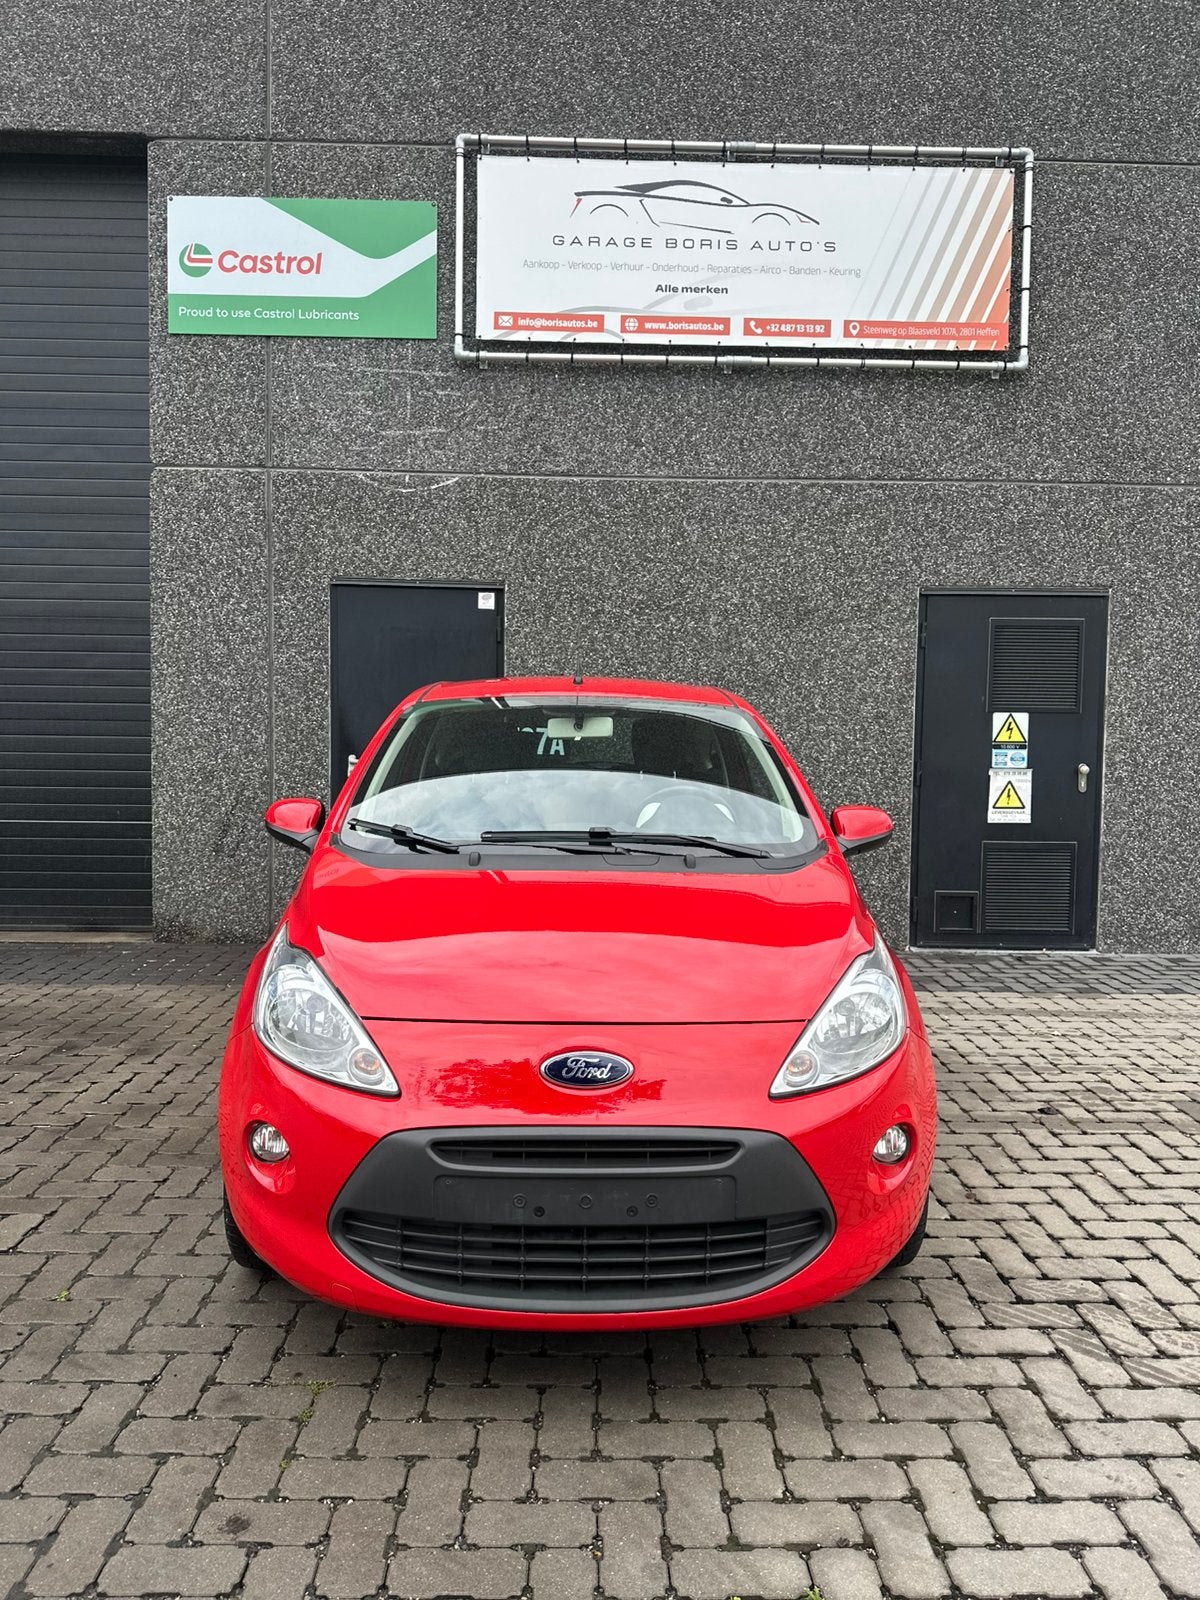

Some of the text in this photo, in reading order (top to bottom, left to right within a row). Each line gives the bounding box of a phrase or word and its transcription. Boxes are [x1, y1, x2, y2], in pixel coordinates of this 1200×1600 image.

[552, 235, 837, 252] GARAGE BORIS AUTO'S
[218, 249, 323, 275] Castrol
[522, 259, 560, 270] Aankoop
[567, 261, 603, 271] Verkoop
[610, 261, 644, 272] Verhuur
[652, 262, 699, 273] Onderhoud
[707, 264, 752, 274] Reparaties
[760, 265, 782, 275] Airco
[788, 266, 821, 276] Banden
[829, 267, 861, 278] Keuring
[655, 284, 729, 295] Alle merken
[178, 306, 360, 321] Proud to use Castrol Lubricants
[517, 317, 598, 329] info@borisautos.be
[644, 320, 725, 332] www.borisautos.be
[814, 324, 825, 334] 92
[863, 325, 897, 337] Steenweg
[898, 328, 908, 336] op
[908, 326, 941, 336] Blaasveld
[959, 327, 976, 337] 2801
[976, 327, 1000, 337] Heffen
[517, 727, 565, 756] 7A
[561, 1056, 612, 1079] Ford
